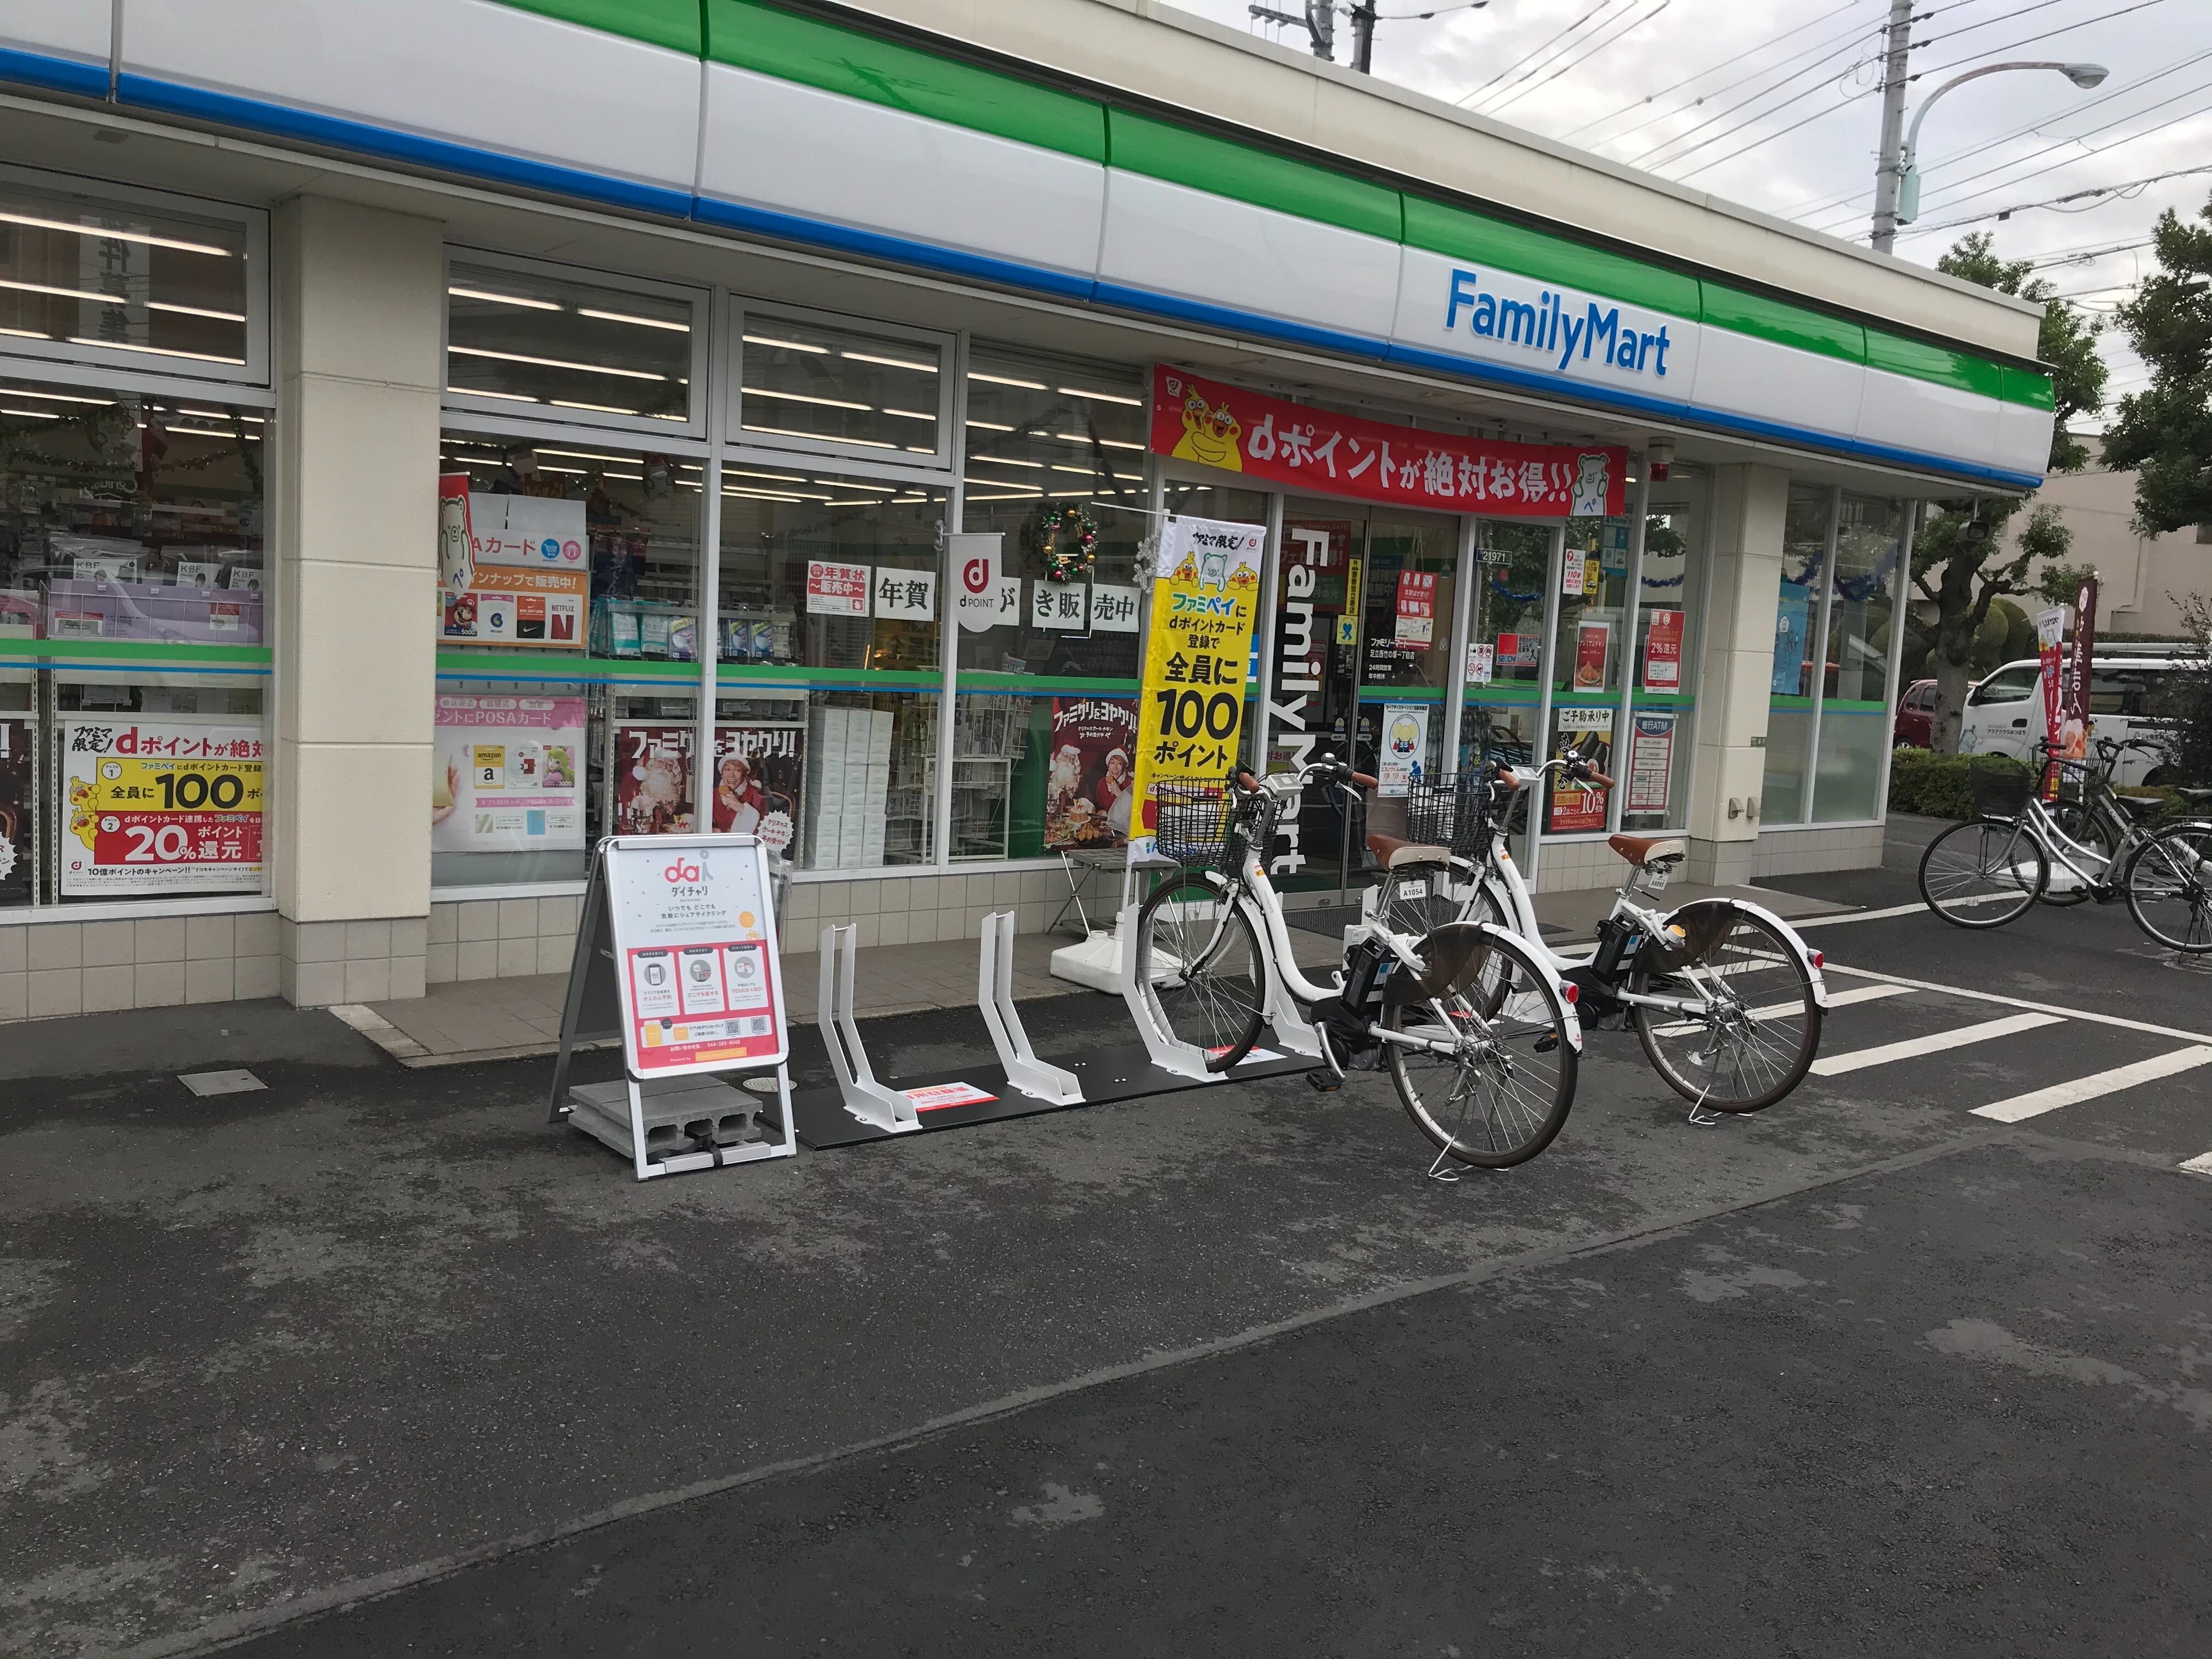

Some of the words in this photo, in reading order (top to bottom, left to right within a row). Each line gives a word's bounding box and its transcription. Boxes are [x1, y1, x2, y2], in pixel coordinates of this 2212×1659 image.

[1446, 268, 1671, 377] FamilyMart
[1249, 414, 1572, 503] dポイントが絶対お得!!
[1482, 551, 1505, 562] 21971
[180, 565, 202, 573] KBF
[233, 570, 256, 578] KBF
[825, 566, 865, 582] 年賀状
[453, 568, 464, 588] ペ
[879, 577, 929, 610] 年賀
[1036, 589, 1080, 619] き販
[1094, 594, 1135, 622] 売中
[960, 595, 967, 607] d
[968, 598, 994, 608] POINT
[1172, 594, 1247, 618] ファミペイに
[1169, 615, 1246, 635] dポイントカード
[1187, 634, 1220, 649] 登録で
[1370, 638, 1407, 648] ファミリーマート
[1651, 642, 1677, 654] 2%還元
[1165, 652, 1238, 685] 全員に
[1156, 689, 1239, 740] 100
[1562, 710, 1610, 723] ご予約承り中
[74, 726, 112, 738] ファミマ
[1641, 720, 1668, 731] 銀行ATM
[71, 737, 114, 753] 限定!
[1153, 741, 1228, 769] ポイント
[1556, 732, 1572, 790] 恵巻
[484, 768, 494, 781] a
[111, 786, 155, 799] 全員に
[155, 773, 244, 809] 100
[247, 788, 263, 799] ポ
[1562, 806, 1580, 815] 2品ごとに
[768, 819, 788, 828] クリスマス
[125, 825, 196, 861] 20%
[198, 826, 243, 838] ポイント
[761, 835, 786, 845] 予約受付中
[198, 841, 242, 860] 還元
[88, 867, 190, 876] 10億ポイントのキャンペーン!!
[671, 885, 709, 898] ダイチャリ
[1403, 888, 1423, 896] A1054
[661, 910, 727, 919] 気軽にシェアサイクリング
